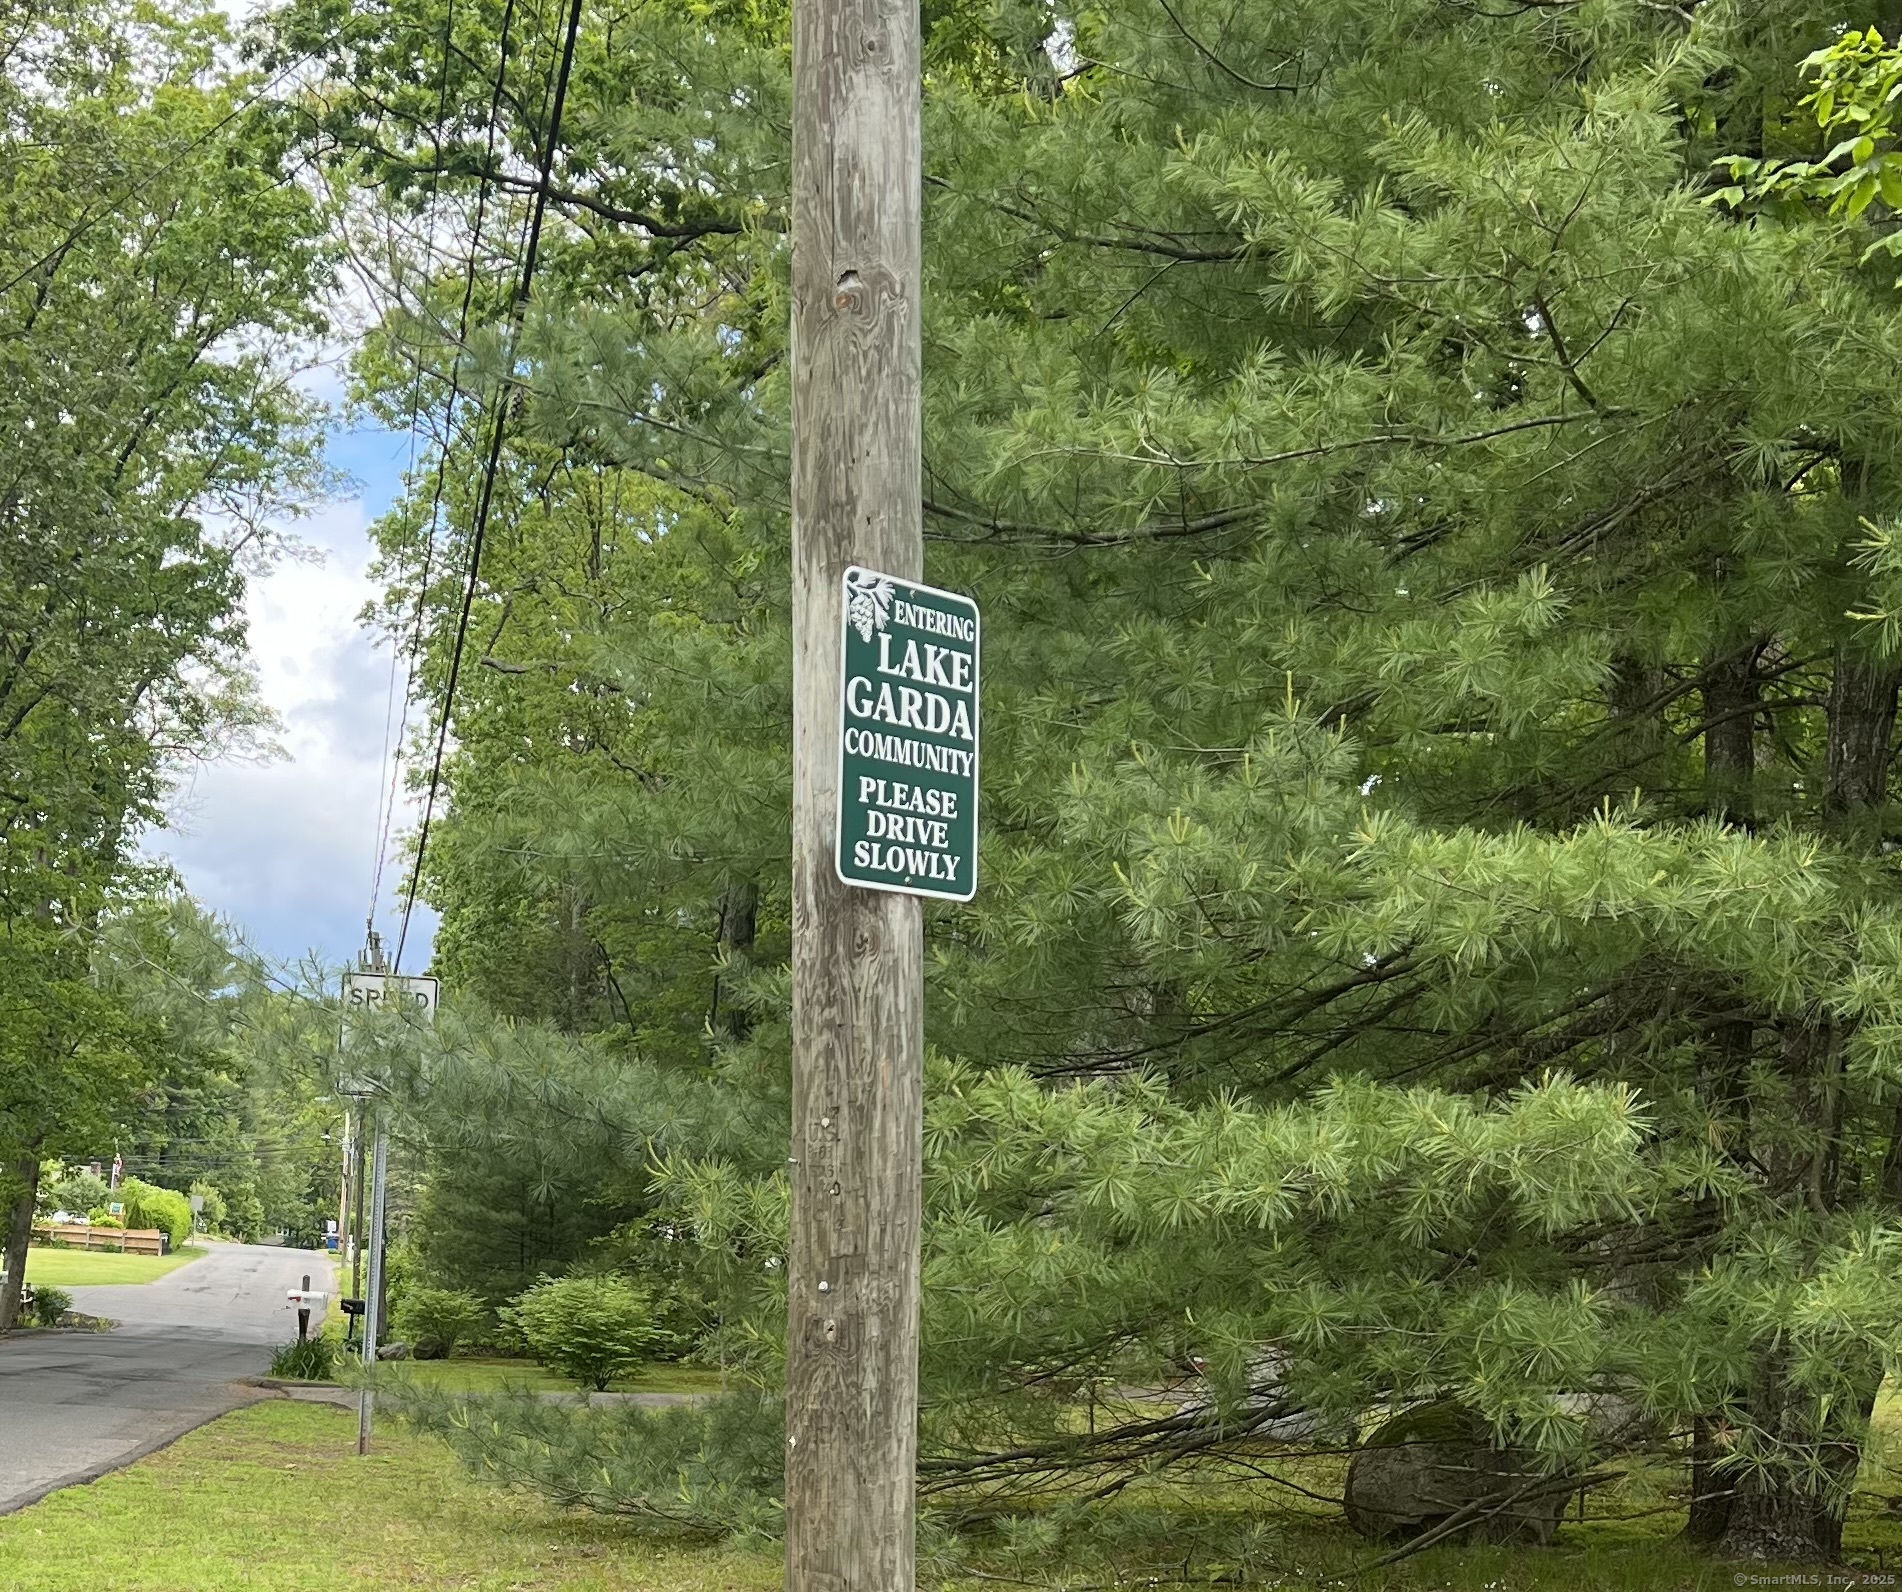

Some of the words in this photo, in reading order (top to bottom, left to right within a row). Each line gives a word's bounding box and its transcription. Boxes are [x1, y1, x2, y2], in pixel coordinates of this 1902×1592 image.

[894, 600, 974, 642] ENTERING
[876, 632, 973, 693] LAKE
[846, 676, 973, 740] GARDA
[844, 727, 973, 777] COMMUNITY
[858, 776, 957, 819] PLEASE
[866, 810, 949, 848] DRIVE
[854, 841, 960, 881] SLOWLY
[350, 988, 428, 1010] SPD
